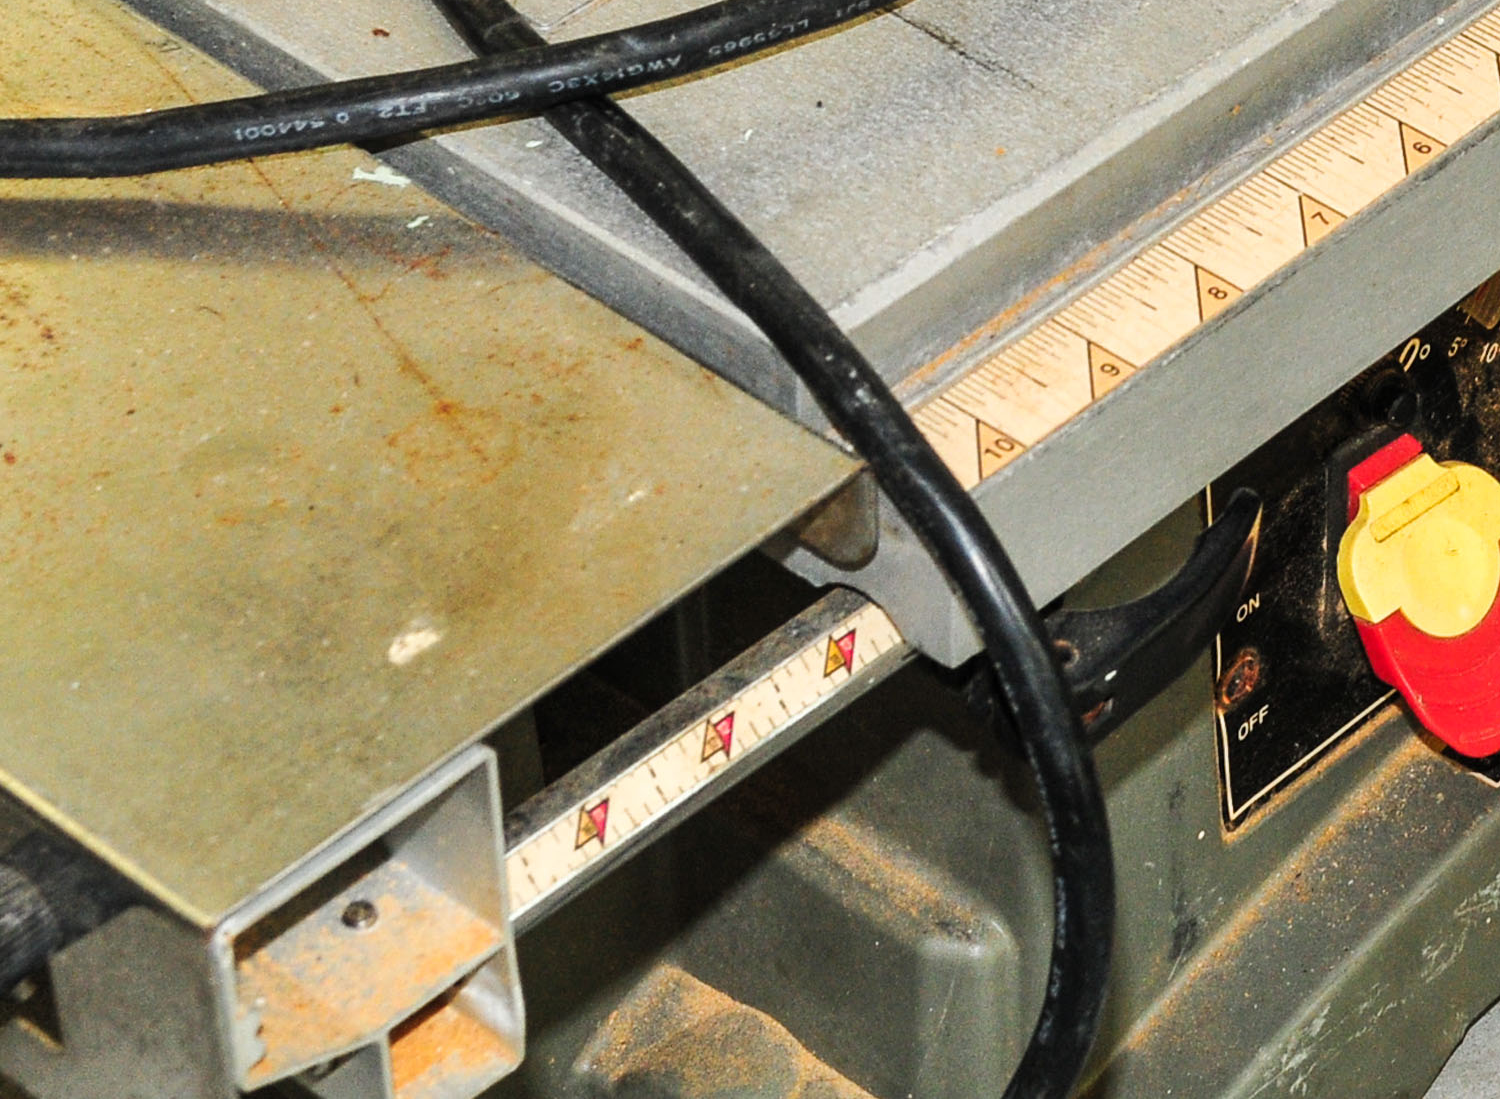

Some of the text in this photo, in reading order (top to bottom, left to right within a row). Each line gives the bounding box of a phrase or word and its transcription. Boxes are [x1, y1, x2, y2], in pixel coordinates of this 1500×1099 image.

[983, 437, 1016, 461] 10
[1099, 362, 1121, 378] 9
[1207, 285, 1229, 301] 8
[1310, 210, 1331, 228] 7
[1412, 140, 1433, 156] 6
[1235, 592, 1262, 624] ON
[1236, 703, 1270, 742] OFF
